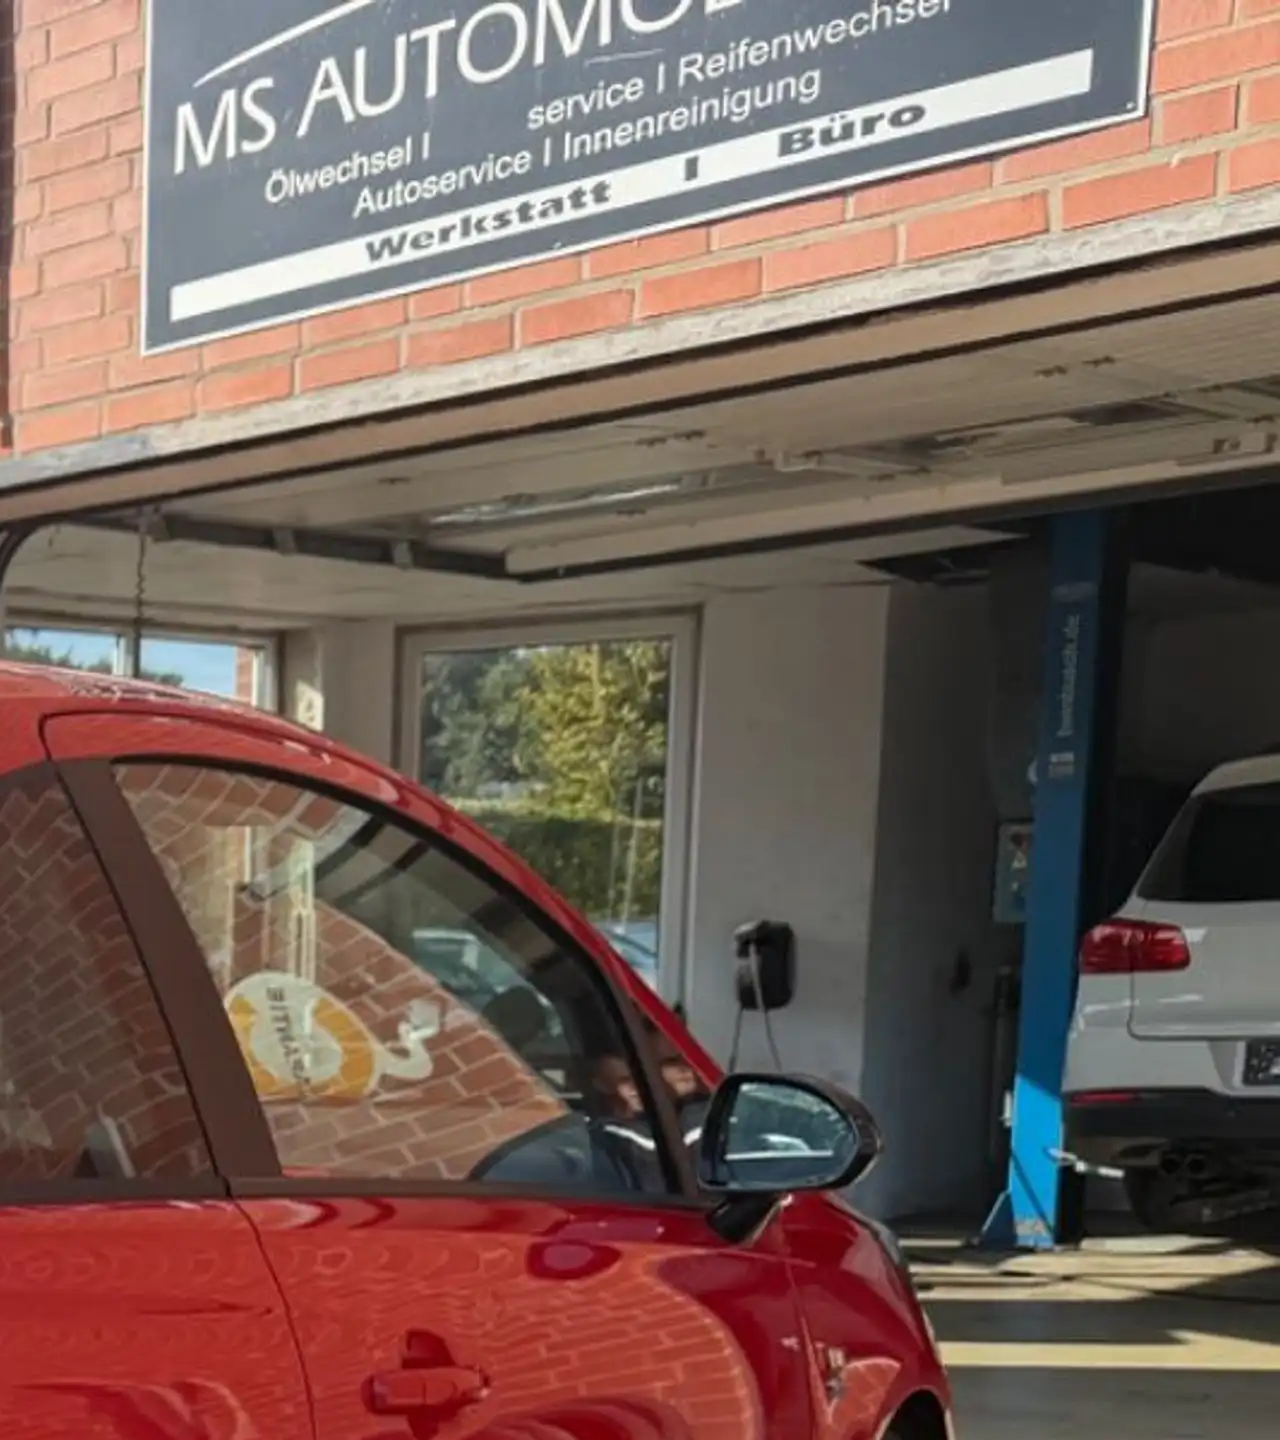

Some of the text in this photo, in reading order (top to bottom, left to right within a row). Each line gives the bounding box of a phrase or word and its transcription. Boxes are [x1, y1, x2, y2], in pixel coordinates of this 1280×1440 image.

[174, 0, 742, 175] MS AUTOM
[265, 136, 412, 204] Ölwechsel
[527, 73, 645, 131] service
[352, 149, 532, 219] Autoservice
[564, 69, 822, 162] Innenreinigung
[365, 179, 613, 262] Werkstatt
[778, 105, 927, 157] Büro
